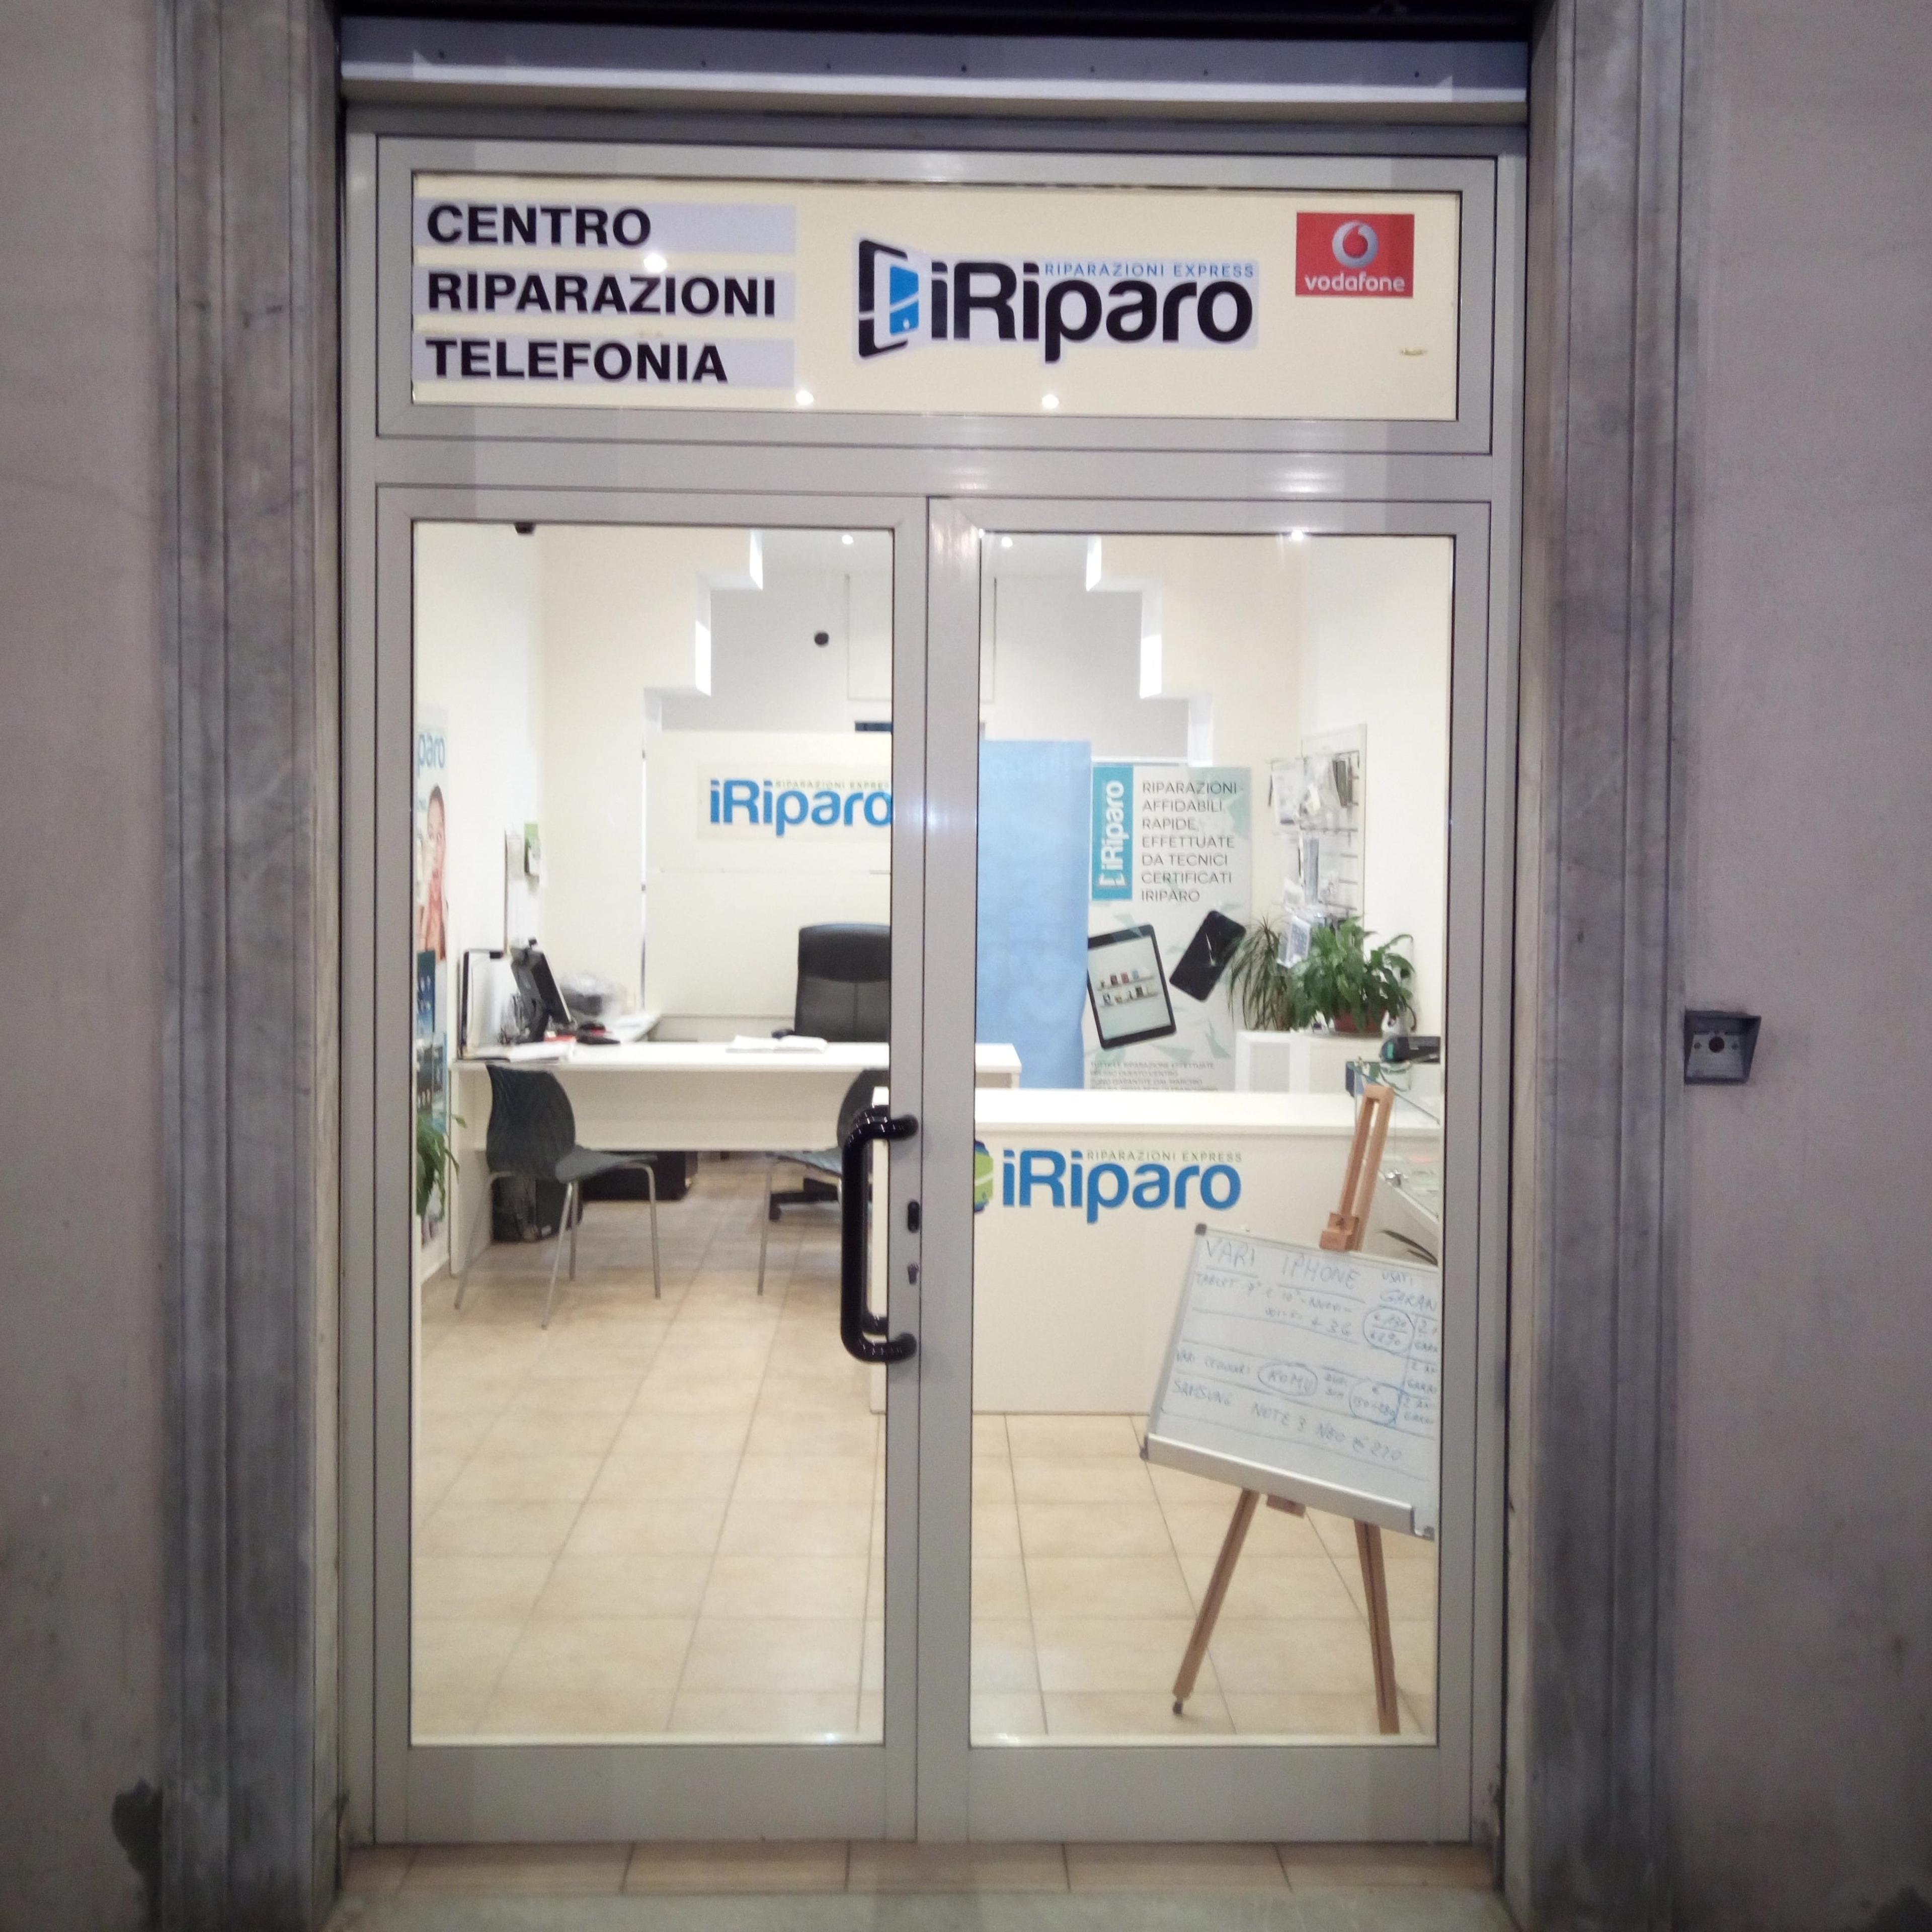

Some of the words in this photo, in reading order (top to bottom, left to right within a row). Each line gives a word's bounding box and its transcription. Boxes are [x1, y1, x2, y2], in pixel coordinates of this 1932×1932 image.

[427, 204, 651, 247] CENTRO
[1045, 262, 1164, 277] RIPARAZIONI
[1173, 263, 1254, 278] EXPRESS
[1304, 272, 1405, 292] vodafone
[428, 271, 775, 316] RIPARAZIONI
[931, 261, 1253, 363] iRiparo
[426, 338, 728, 383] TELEFONIA
[1142, 781, 1237, 794] RIPARAZIONI
[710, 779, 891, 837] iRiparo
[1142, 835, 1235, 848] EFFETTUATE
[1142, 854, 1164, 866] DA
[1168, 854, 1228, 866] TECNICI
[1141, 871, 1232, 884] CERTIFICATI
[1141, 890, 1200, 902] IRIPARO
[1087, 1149, 1176, 1162] RIPARAZIONI
[1183, 1151, 1243, 1162] EXPRESS
[1003, 1149, 1241, 1224] iRiparo
[1205, 1237, 1255, 1268] VARI
[1280, 1252, 1360, 1290] IPHONE
